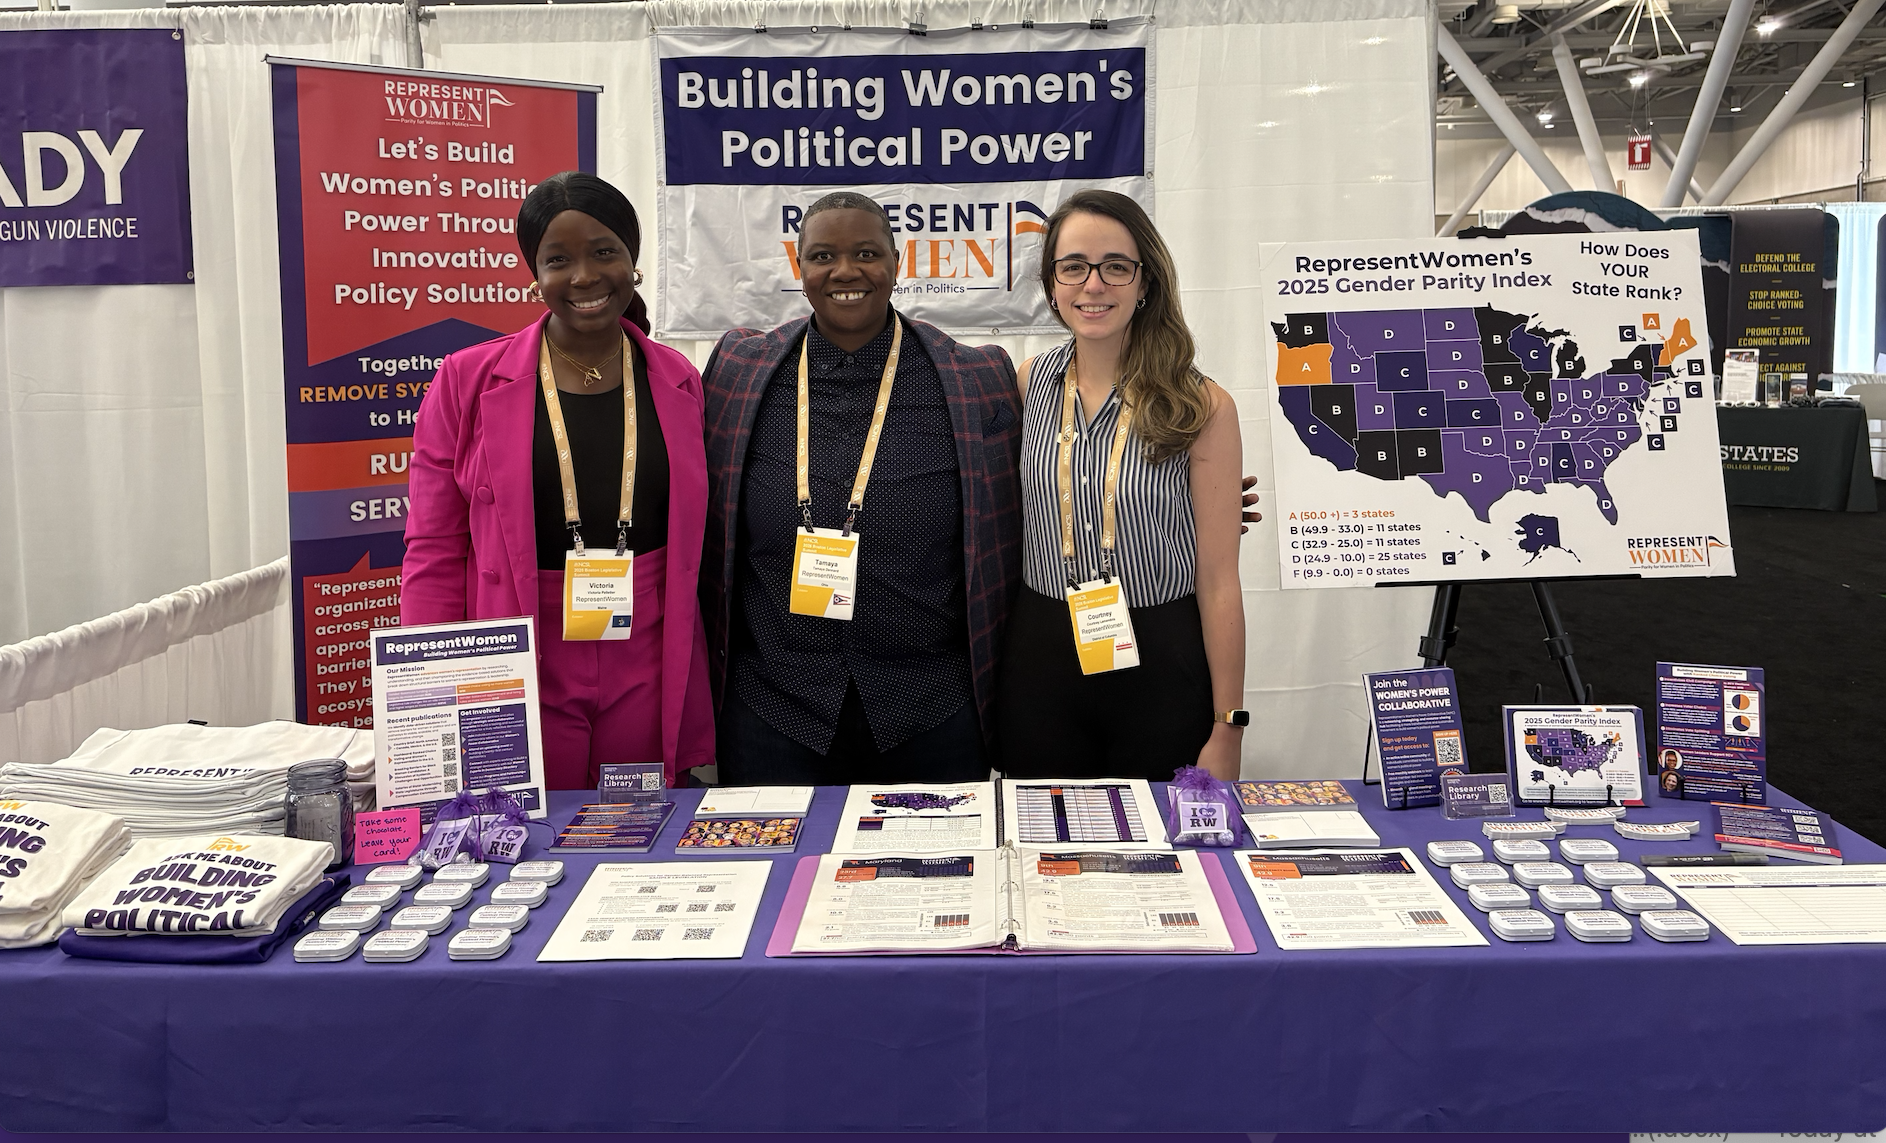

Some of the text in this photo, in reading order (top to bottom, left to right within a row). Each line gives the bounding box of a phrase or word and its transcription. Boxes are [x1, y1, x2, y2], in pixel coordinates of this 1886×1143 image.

[384, 80, 484, 101] REPRESENT
[677, 59, 1133, 122] Building Women's
[384, 96, 484, 122] WOMEN
[378, 136, 514, 164] Let’s Build
[721, 127, 1093, 169] Political Power
[320, 172, 453, 197] Women’s
[344, 210, 430, 233] Power
[782, 203, 1000, 234] RESENT
[0, 217, 138, 241] GUN VIOLENCE
[1579, 240, 1670, 260] How Does
[373, 246, 519, 269] Innovative
[780, 238, 999, 281] MEN
[1294, 247, 1533, 275] RepresentWomen’s
[1755, 253, 1801, 263] DEFEND THE
[1599, 261, 1649, 280] YOUR
[1740, 263, 1816, 273] ELECTORAL COLLEGE
[913, 283, 965, 295] in Politics
[1277, 271, 1553, 297] 2025 Gender Parity Index
[334, 281, 546, 311] Policy Solution
[1572, 280, 1682, 302] State Rank?
[1749, 290, 1803, 300] STOP RANKED-
[1747, 300, 1804, 310] CHOICE VOTING
[1745, 326, 1804, 337] PROMOTE STATE
[1738, 336, 1811, 347] ECONOMIC GROWTH
[1775, 362, 1806, 372] AGAINST
[299, 384, 389, 403] REMOVE
[369, 411, 391, 426] to
[1720, 444, 1799, 463] STATES
[370, 452, 414, 475] RU
[1289, 512, 1297, 520] A
[1300, 510, 1327, 522] (50.0
[1352, 510, 1358, 518] 3
[1361, 509, 1395, 518] states
[1290, 526, 1298, 534] B
[1301, 525, 1328, 536] (49.9
[1338, 524, 1364, 535] 33.0)
[1376, 524, 1384, 532] 11
[1387, 523, 1421, 532] states
[1627, 536, 1703, 549] REPRESENT
[1628, 548, 1704, 565] WOMEN
[815, 559, 838, 568] Tamaya
[801, 570, 849, 582] RepresentWomen
[1293, 570, 1300, 578] F
[1303, 568, 1323, 579] (9.9
[1333, 567, 1353, 578] 0.0)
[1376, 567, 1410, 576] states
[1087, 611, 1112, 621] Courtney
[315, 619, 369, 636] across
[1081, 622, 1124, 635] RepresentWomen
[385, 633, 517, 656] RepresentWomen
[423, 650, 448, 658] Building
[448, 648, 476, 656] Women's
[475, 645, 499, 653] Political
[400, 665, 425, 673] Mission
[317, 679, 357, 695] They
[1373, 678, 1408, 689] Join the
[1375, 687, 1450, 700] WOMEN'S POWER
[472, 707, 500, 715] Involved
[1378, 698, 1451, 711] COLLABORATIVE
[411, 712, 452, 723] publications
[1574, 718, 1598, 726] Parity
[1448, 785, 1488, 793] Research
[359, 816, 407, 827] Take some
[1189, 817, 1218, 827] RW
[366, 826, 407, 835] chocolate,
[211, 843, 251, 851] RW
[360, 836, 412, 848] Leave your
[373, 847, 401, 858] card!
[160, 852, 277, 872] ASK ME ABOUT
[129, 863, 277, 888] BUILDING
[113, 885, 261, 911] WOMEN'S
[84, 908, 245, 932] POLITICAL
